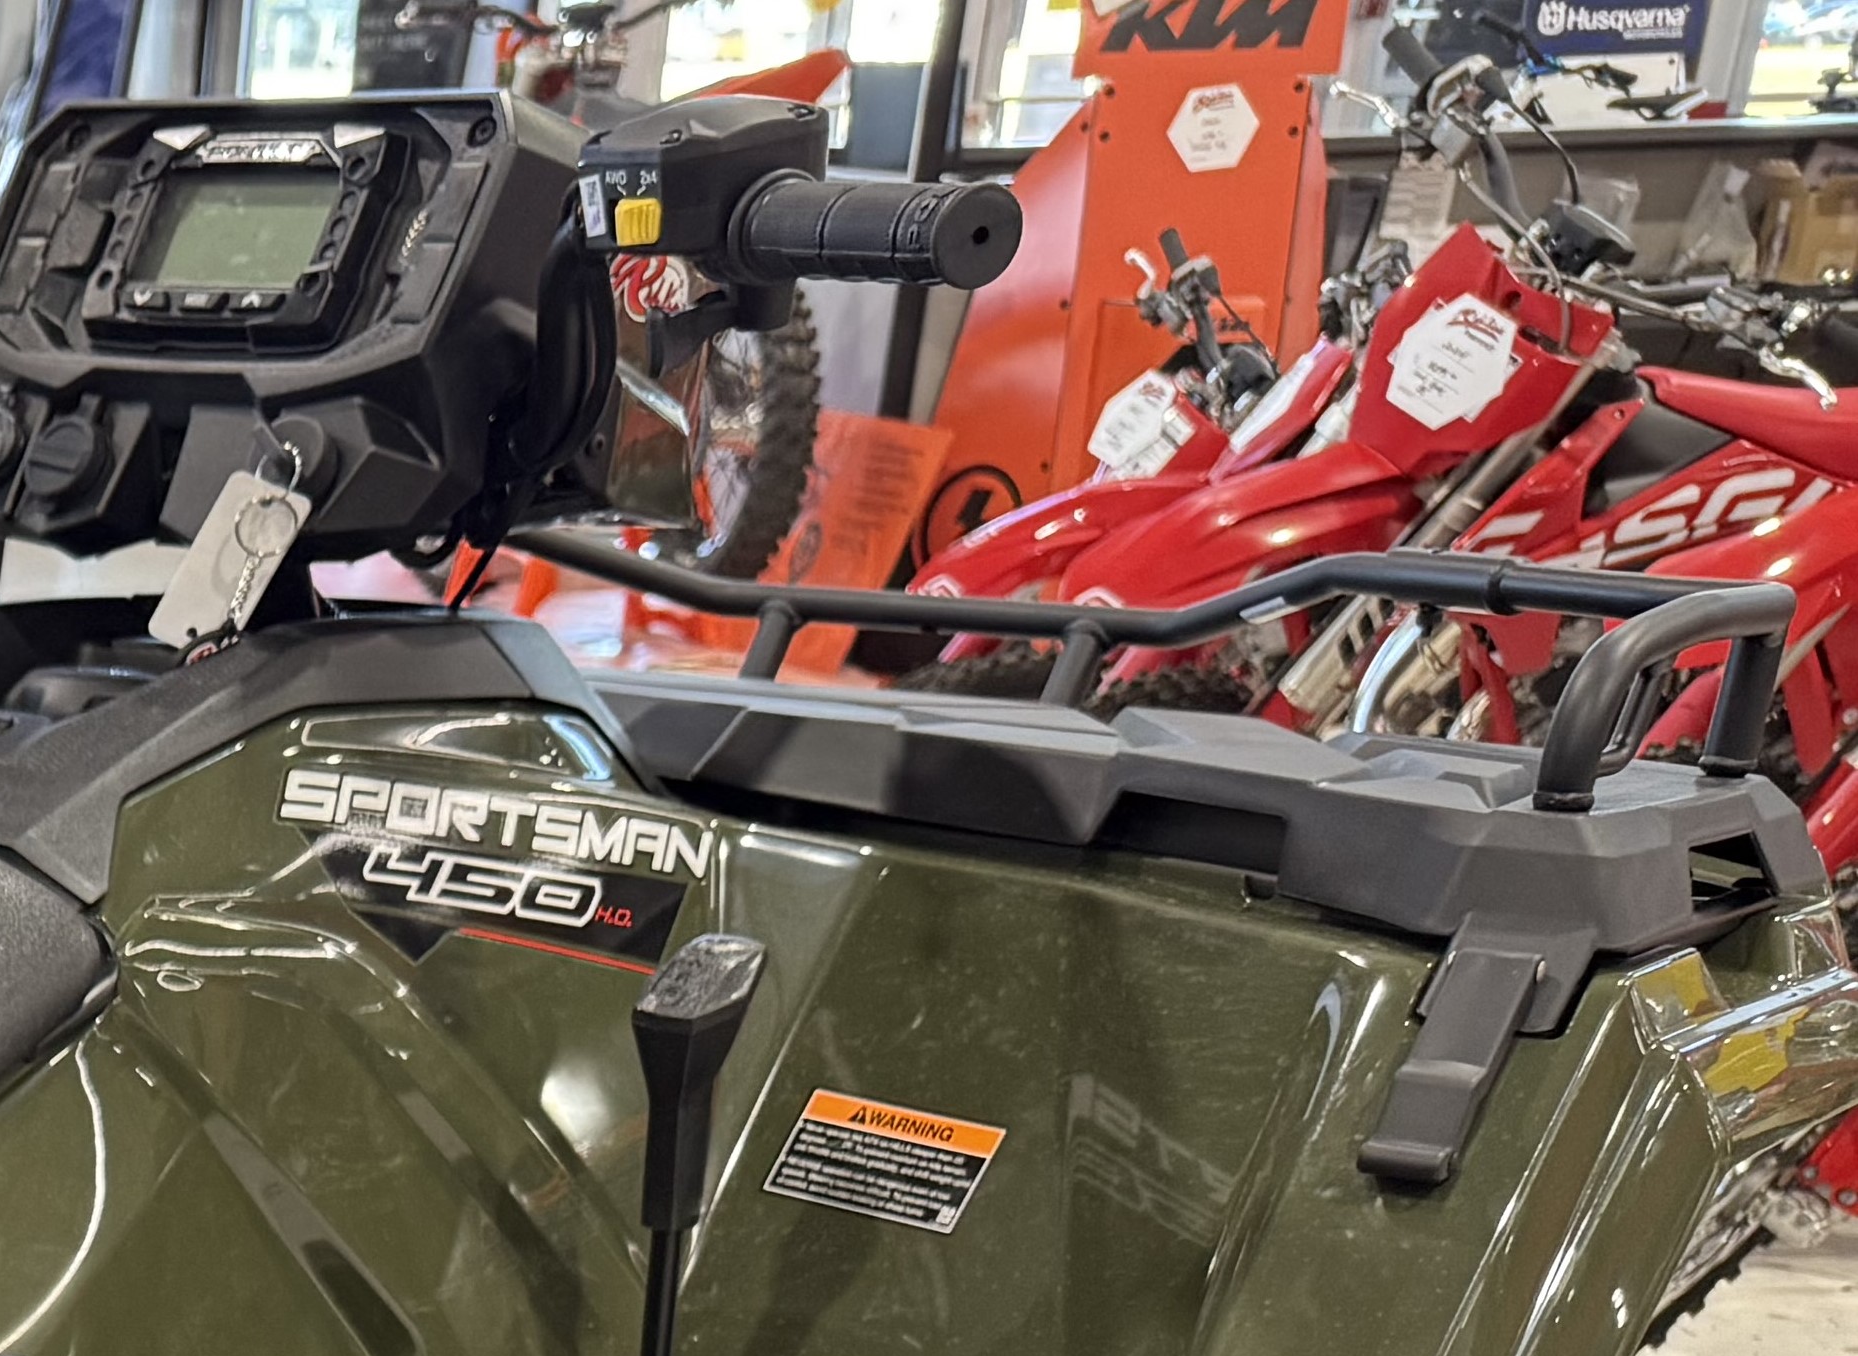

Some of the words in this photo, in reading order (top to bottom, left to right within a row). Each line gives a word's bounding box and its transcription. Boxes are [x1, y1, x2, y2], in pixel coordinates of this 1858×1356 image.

[1566, 5, 1686, 32] Husqvarna
[605, 170, 627, 184] AWD
[280, 769, 713, 879] SPORTSMAN
[363, 846, 604, 929] 450
[868, 1109, 955, 1143] WARNING
